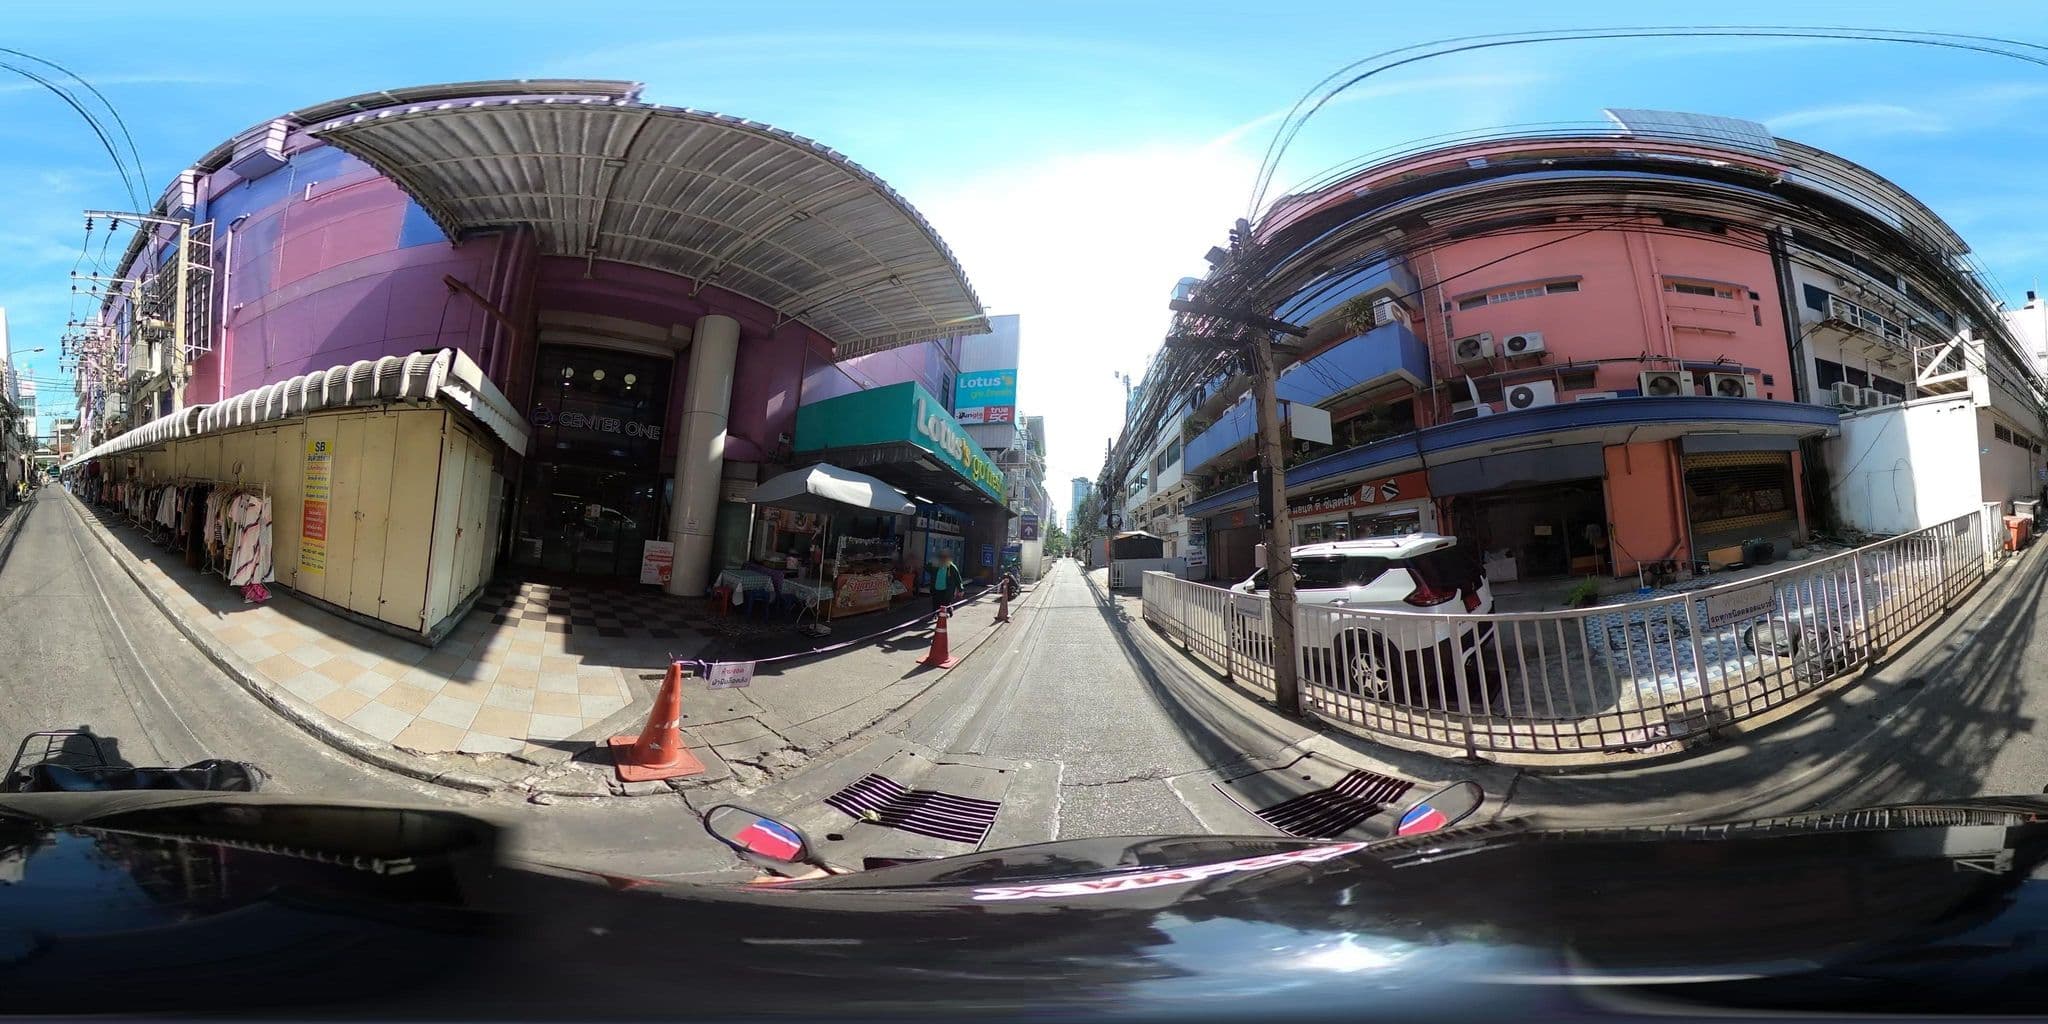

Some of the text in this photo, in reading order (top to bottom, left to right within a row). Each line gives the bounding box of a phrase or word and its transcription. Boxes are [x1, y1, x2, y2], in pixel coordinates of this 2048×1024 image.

[990, 406, 1009, 414] true
[989, 413, 1009, 422] 5G
[558, 411, 661, 440] CENTER ONE
[917, 397, 971, 468] Lotus's
[314, 441, 326, 452] SB
